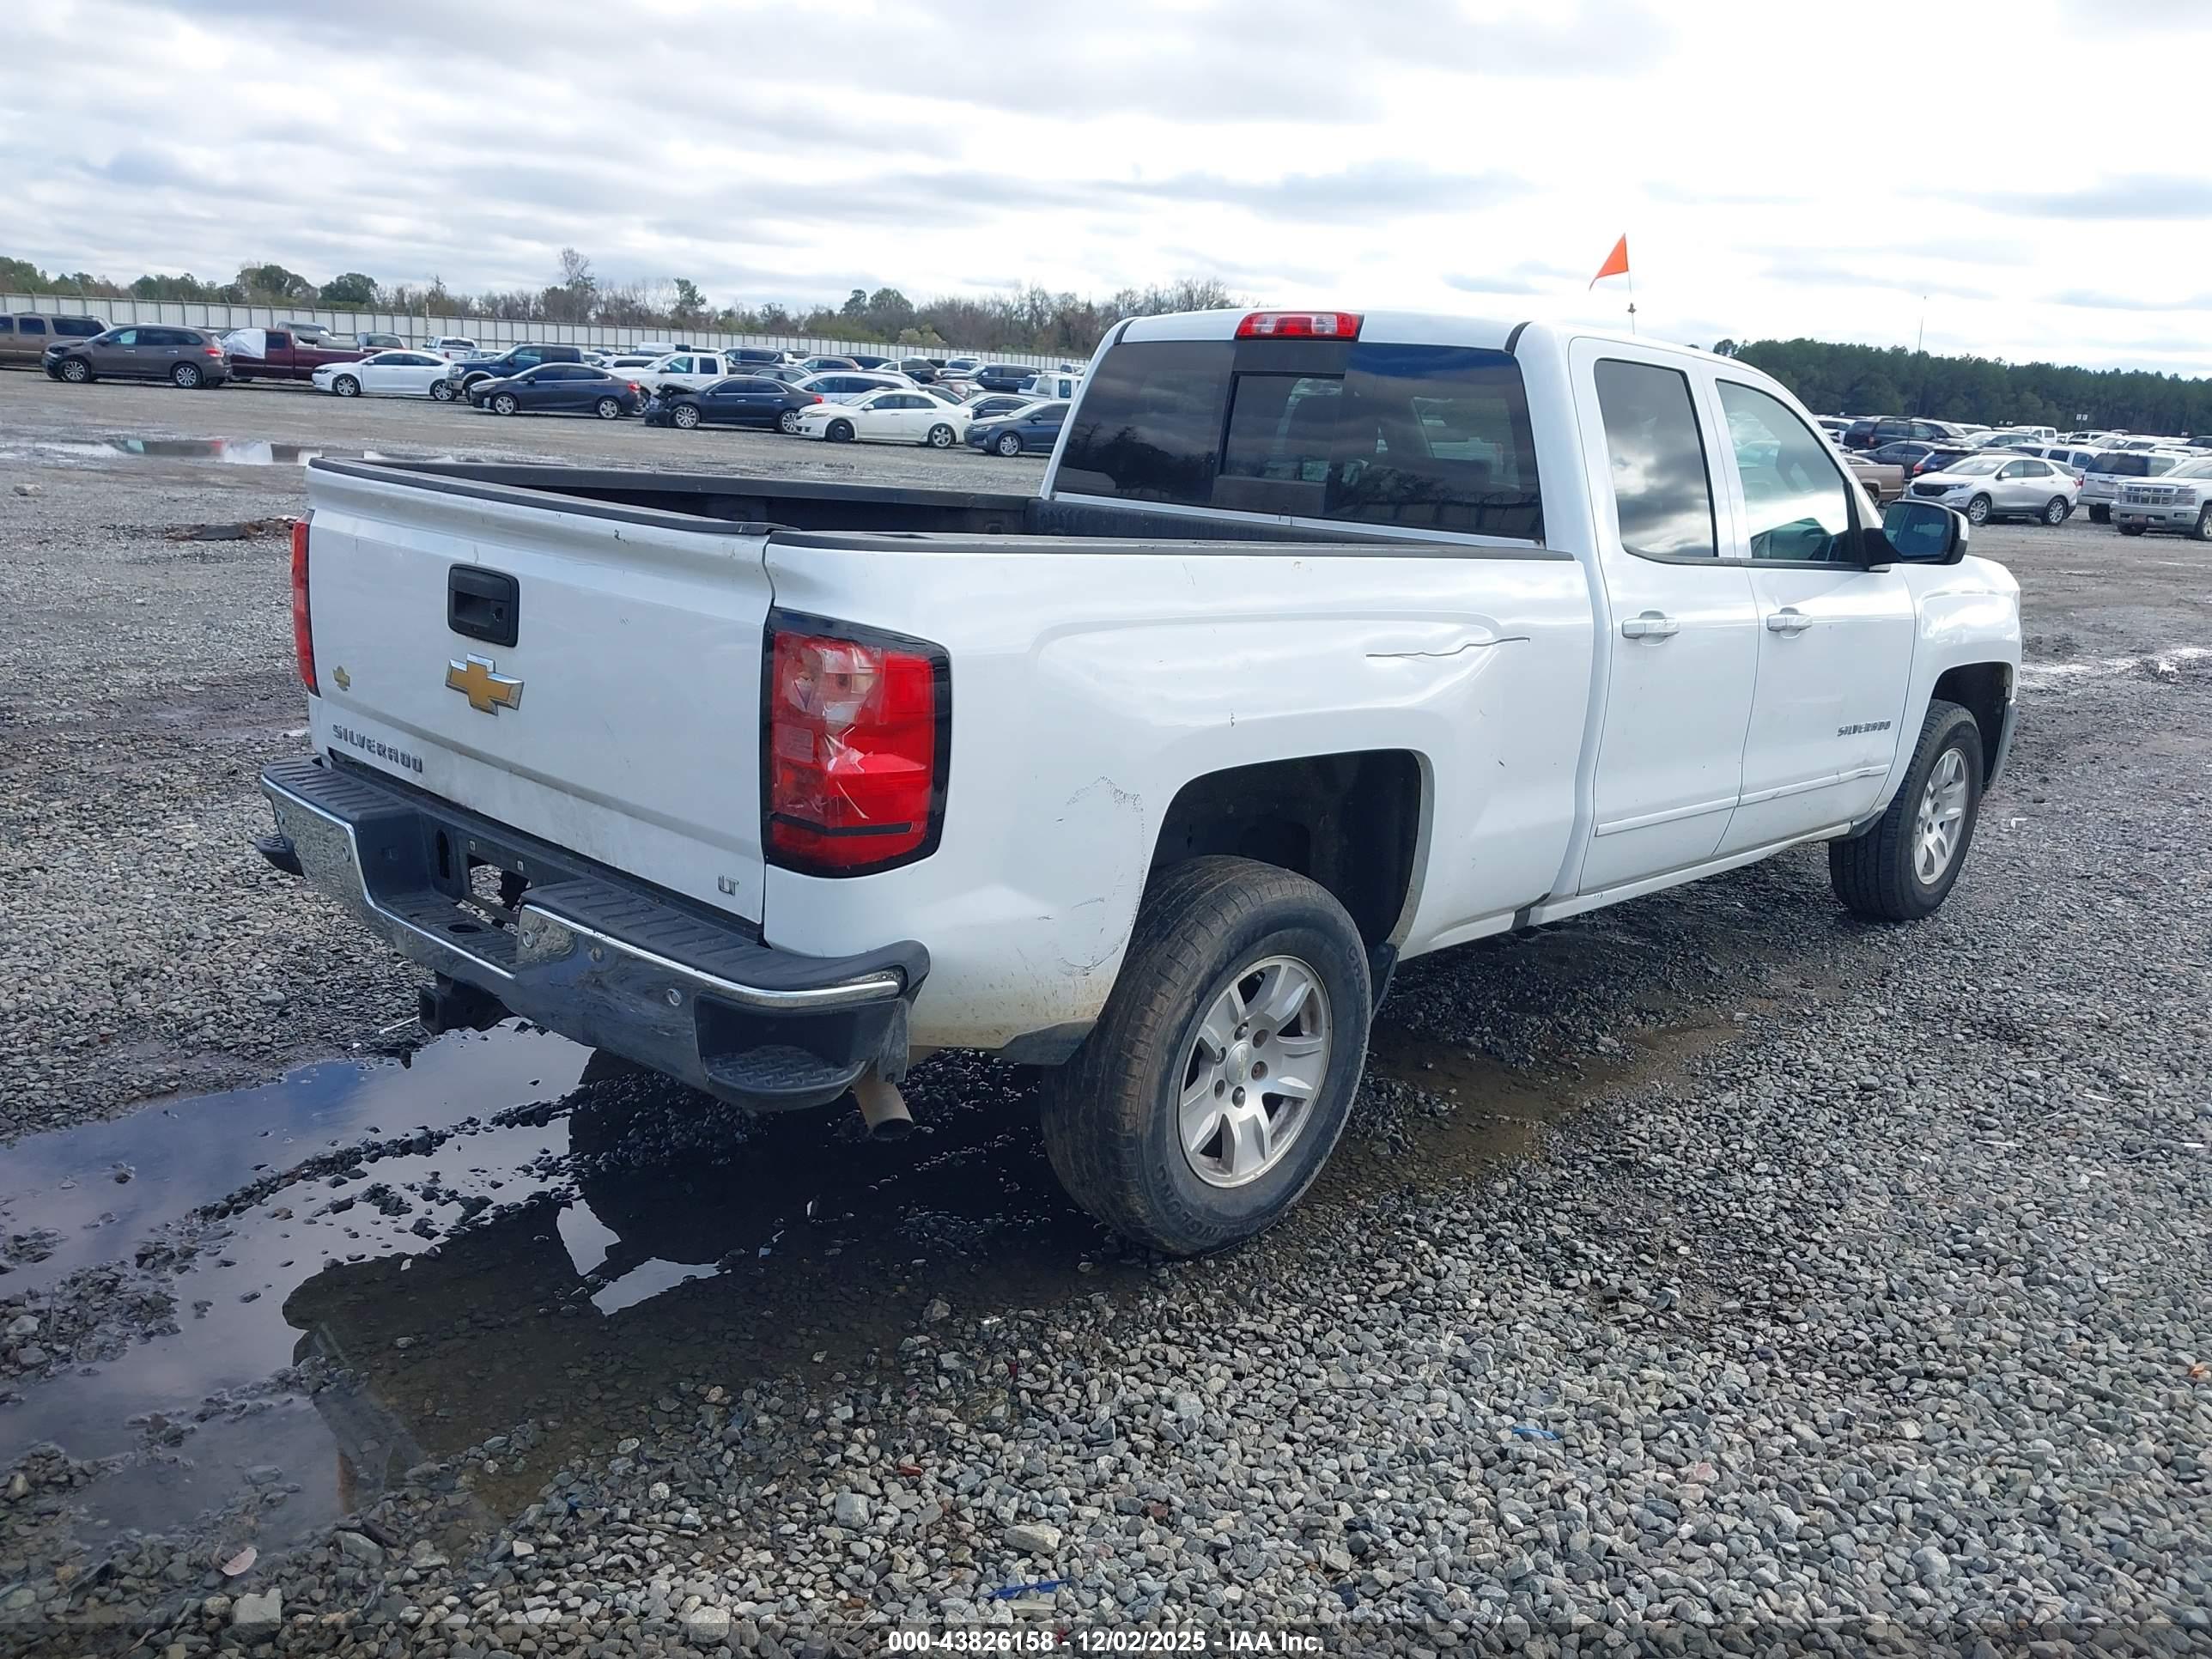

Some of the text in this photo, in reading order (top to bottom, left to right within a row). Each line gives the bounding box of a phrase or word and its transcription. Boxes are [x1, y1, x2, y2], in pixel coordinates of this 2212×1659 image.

[1837, 720, 1891, 737] SILVERADO
[332, 723, 423, 773] SILVERADO
[718, 874, 739, 896] LT
